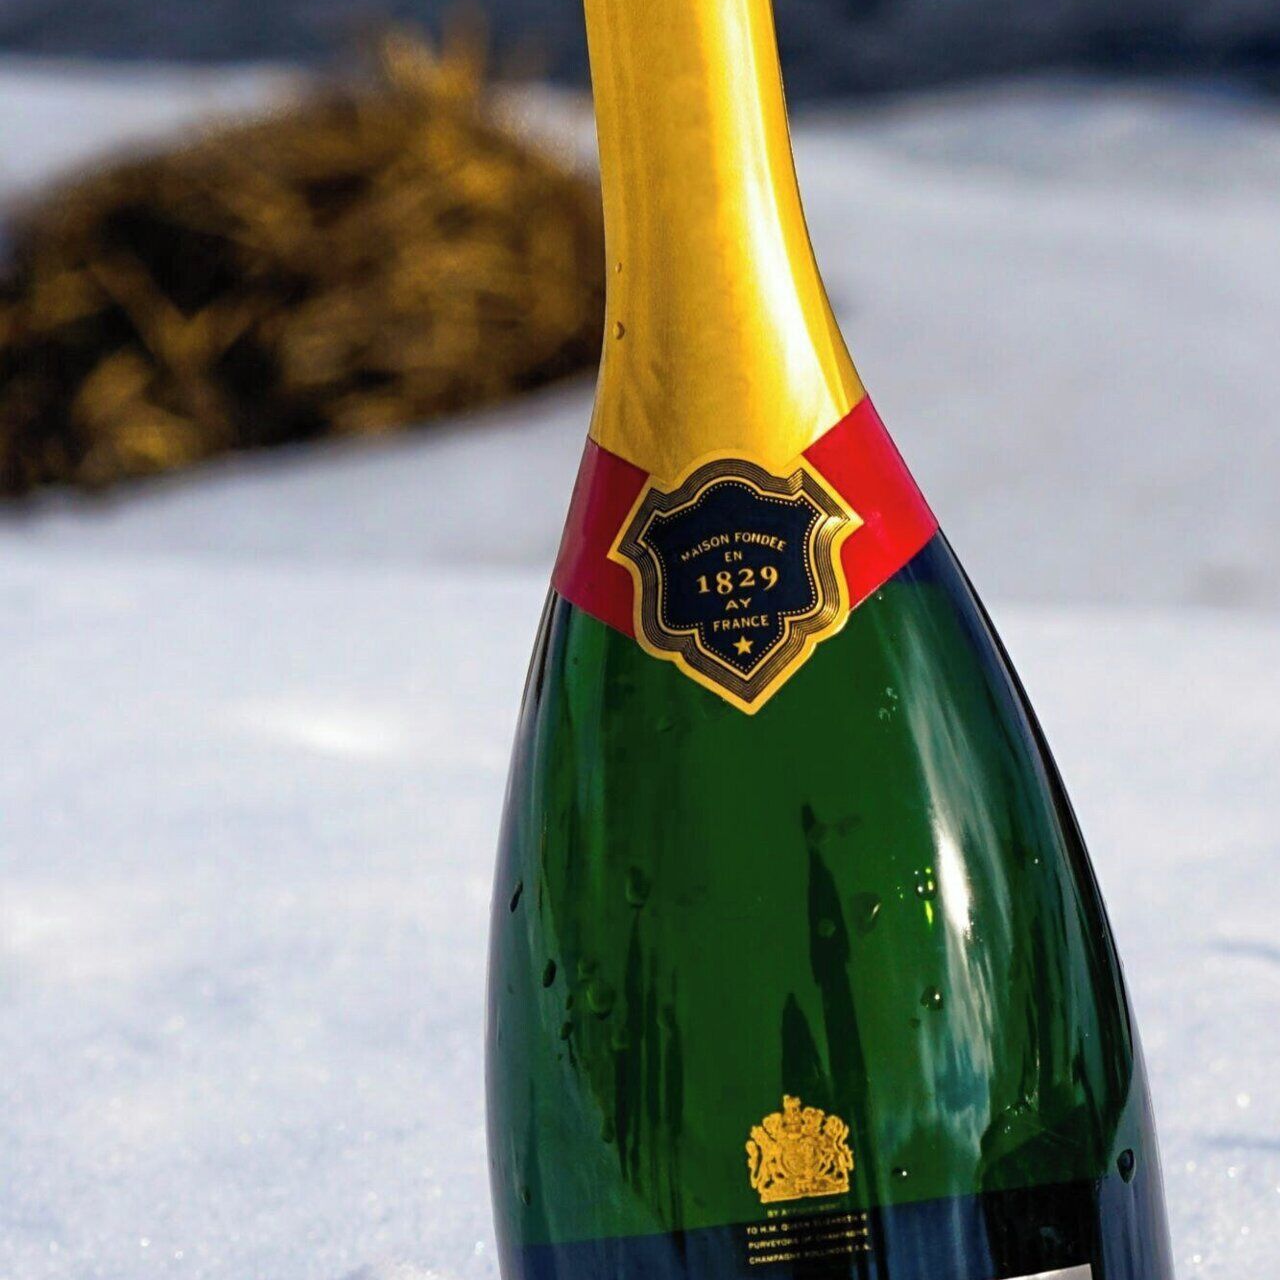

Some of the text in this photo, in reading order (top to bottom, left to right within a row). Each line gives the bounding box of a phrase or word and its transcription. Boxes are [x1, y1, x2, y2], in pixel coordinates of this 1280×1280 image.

[681, 534, 729, 561] MAISON
[724, 551, 742, 562] EN
[696, 566, 778, 595] 1829
[725, 597, 751, 610] AY
[713, 614, 769, 632] FRANCE
